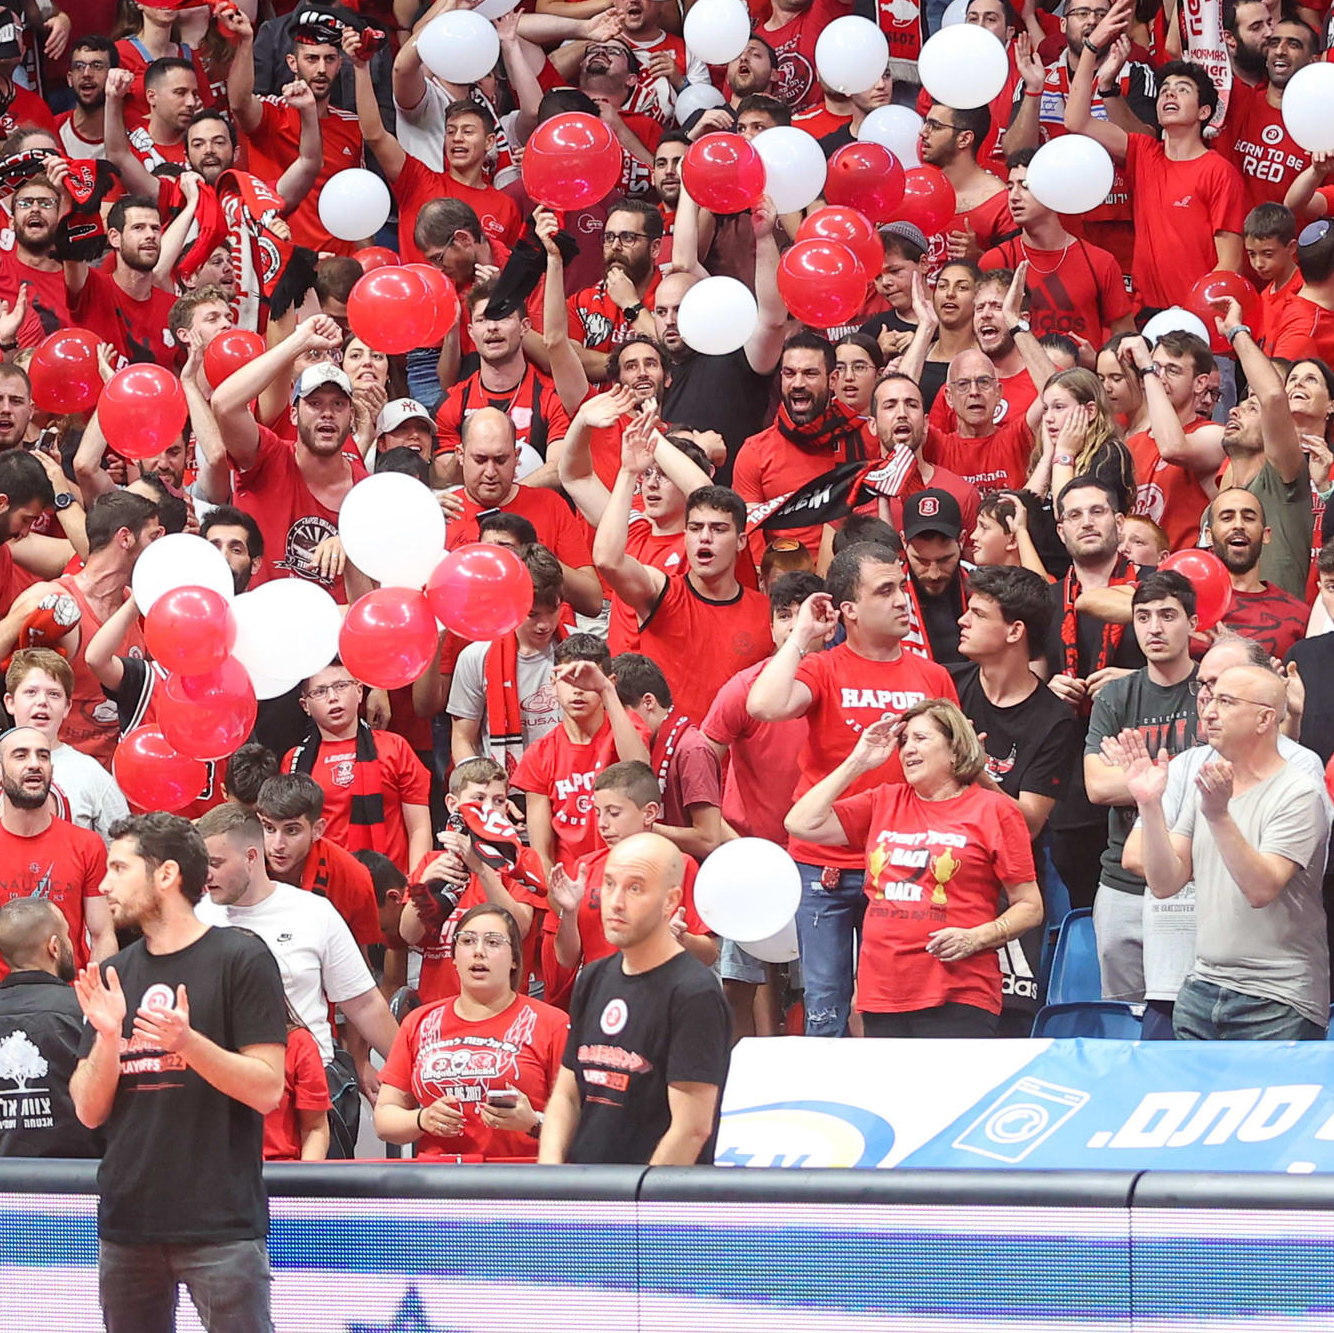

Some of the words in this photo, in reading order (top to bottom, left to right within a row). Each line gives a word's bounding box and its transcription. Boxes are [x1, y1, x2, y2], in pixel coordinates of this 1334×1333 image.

[1243, 157, 1285, 183] RED
[1267, 147, 1286, 162] TO
[1287, 156, 1305, 172] BE
[889, 847, 929, 869] BACK
[884, 881, 924, 903] BACK
[22, 1097, 50, 1114] צוות
[1087, 1084, 1322, 1150] סתם.
